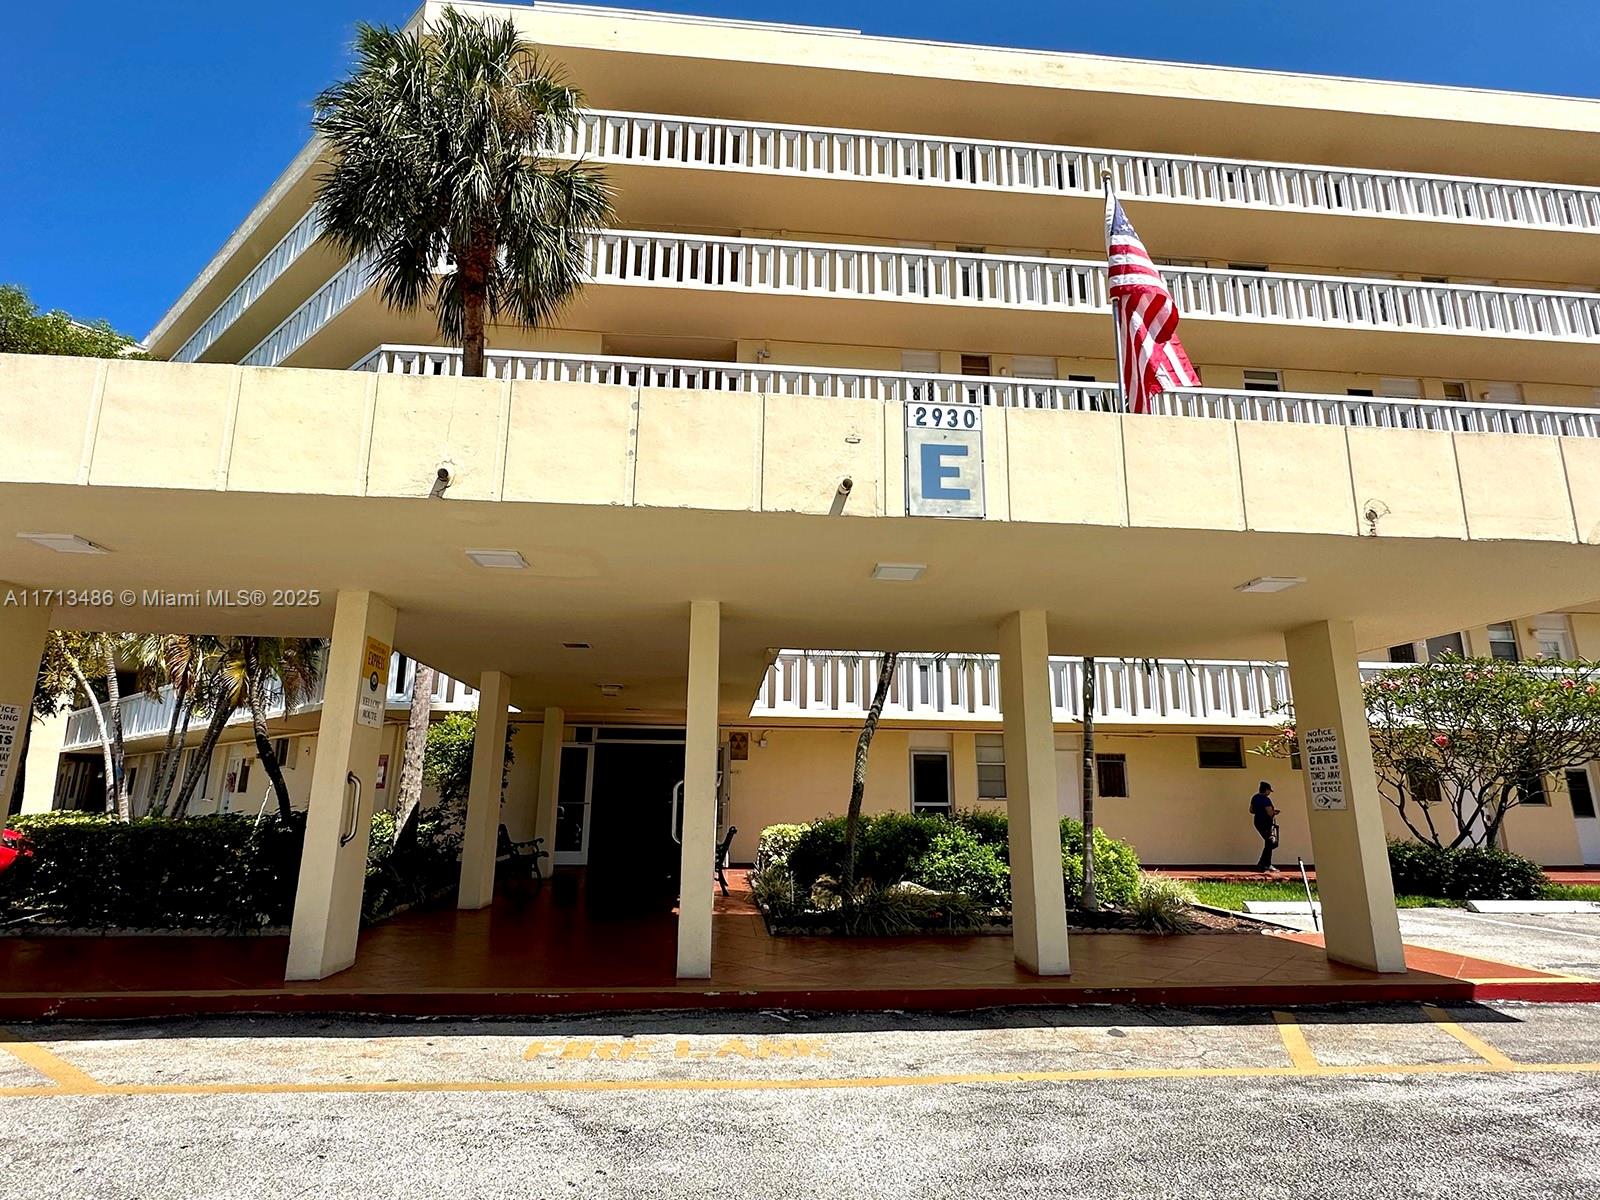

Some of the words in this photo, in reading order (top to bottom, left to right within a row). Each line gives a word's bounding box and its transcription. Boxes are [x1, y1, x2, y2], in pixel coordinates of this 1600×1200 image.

[915, 406, 976, 429] 2930
[920, 443, 971, 500] E
[0, 706, 16, 714] ICE
[1307, 729, 1333, 737] NOTICE
[1305, 736, 1337, 745] PARKING
[1309, 754, 1339, 765] CARS
[1310, 771, 1326, 781] TOWED
[1327, 771, 1341, 780] AWAY
[1312, 785, 1343, 794] EXPENSE
[522, 1039, 658, 1062] FIRE
[673, 1039, 833, 1060] LANE
